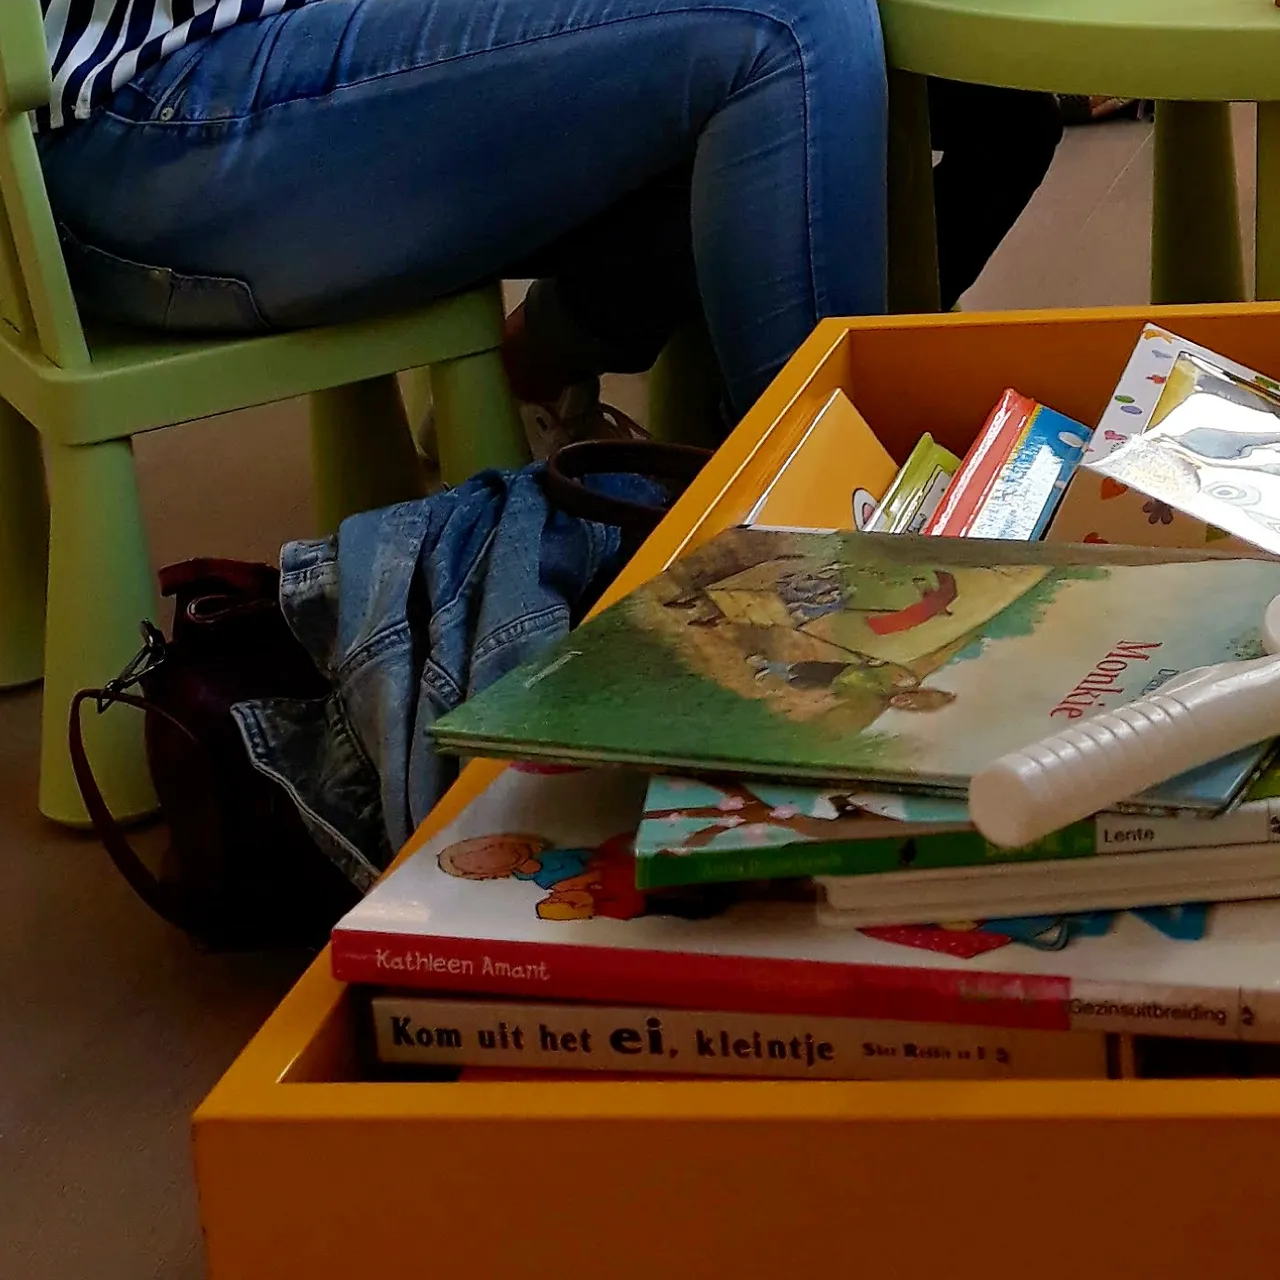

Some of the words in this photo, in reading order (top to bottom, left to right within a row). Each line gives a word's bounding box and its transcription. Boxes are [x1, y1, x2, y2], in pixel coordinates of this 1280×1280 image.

[1050, 640, 1163, 719] Monkie
[1103, 828, 1155, 844] Lente
[375, 949, 475, 976] Kathleen
[481, 955, 552, 981] Amant
[1069, 998, 1227, 1026] Gezinsuitbreiding
[390, 1016, 462, 1048] Kom
[477, 1022, 525, 1051] uit
[538, 1024, 593, 1054] het
[695, 1029, 837, 1068] kleintje
